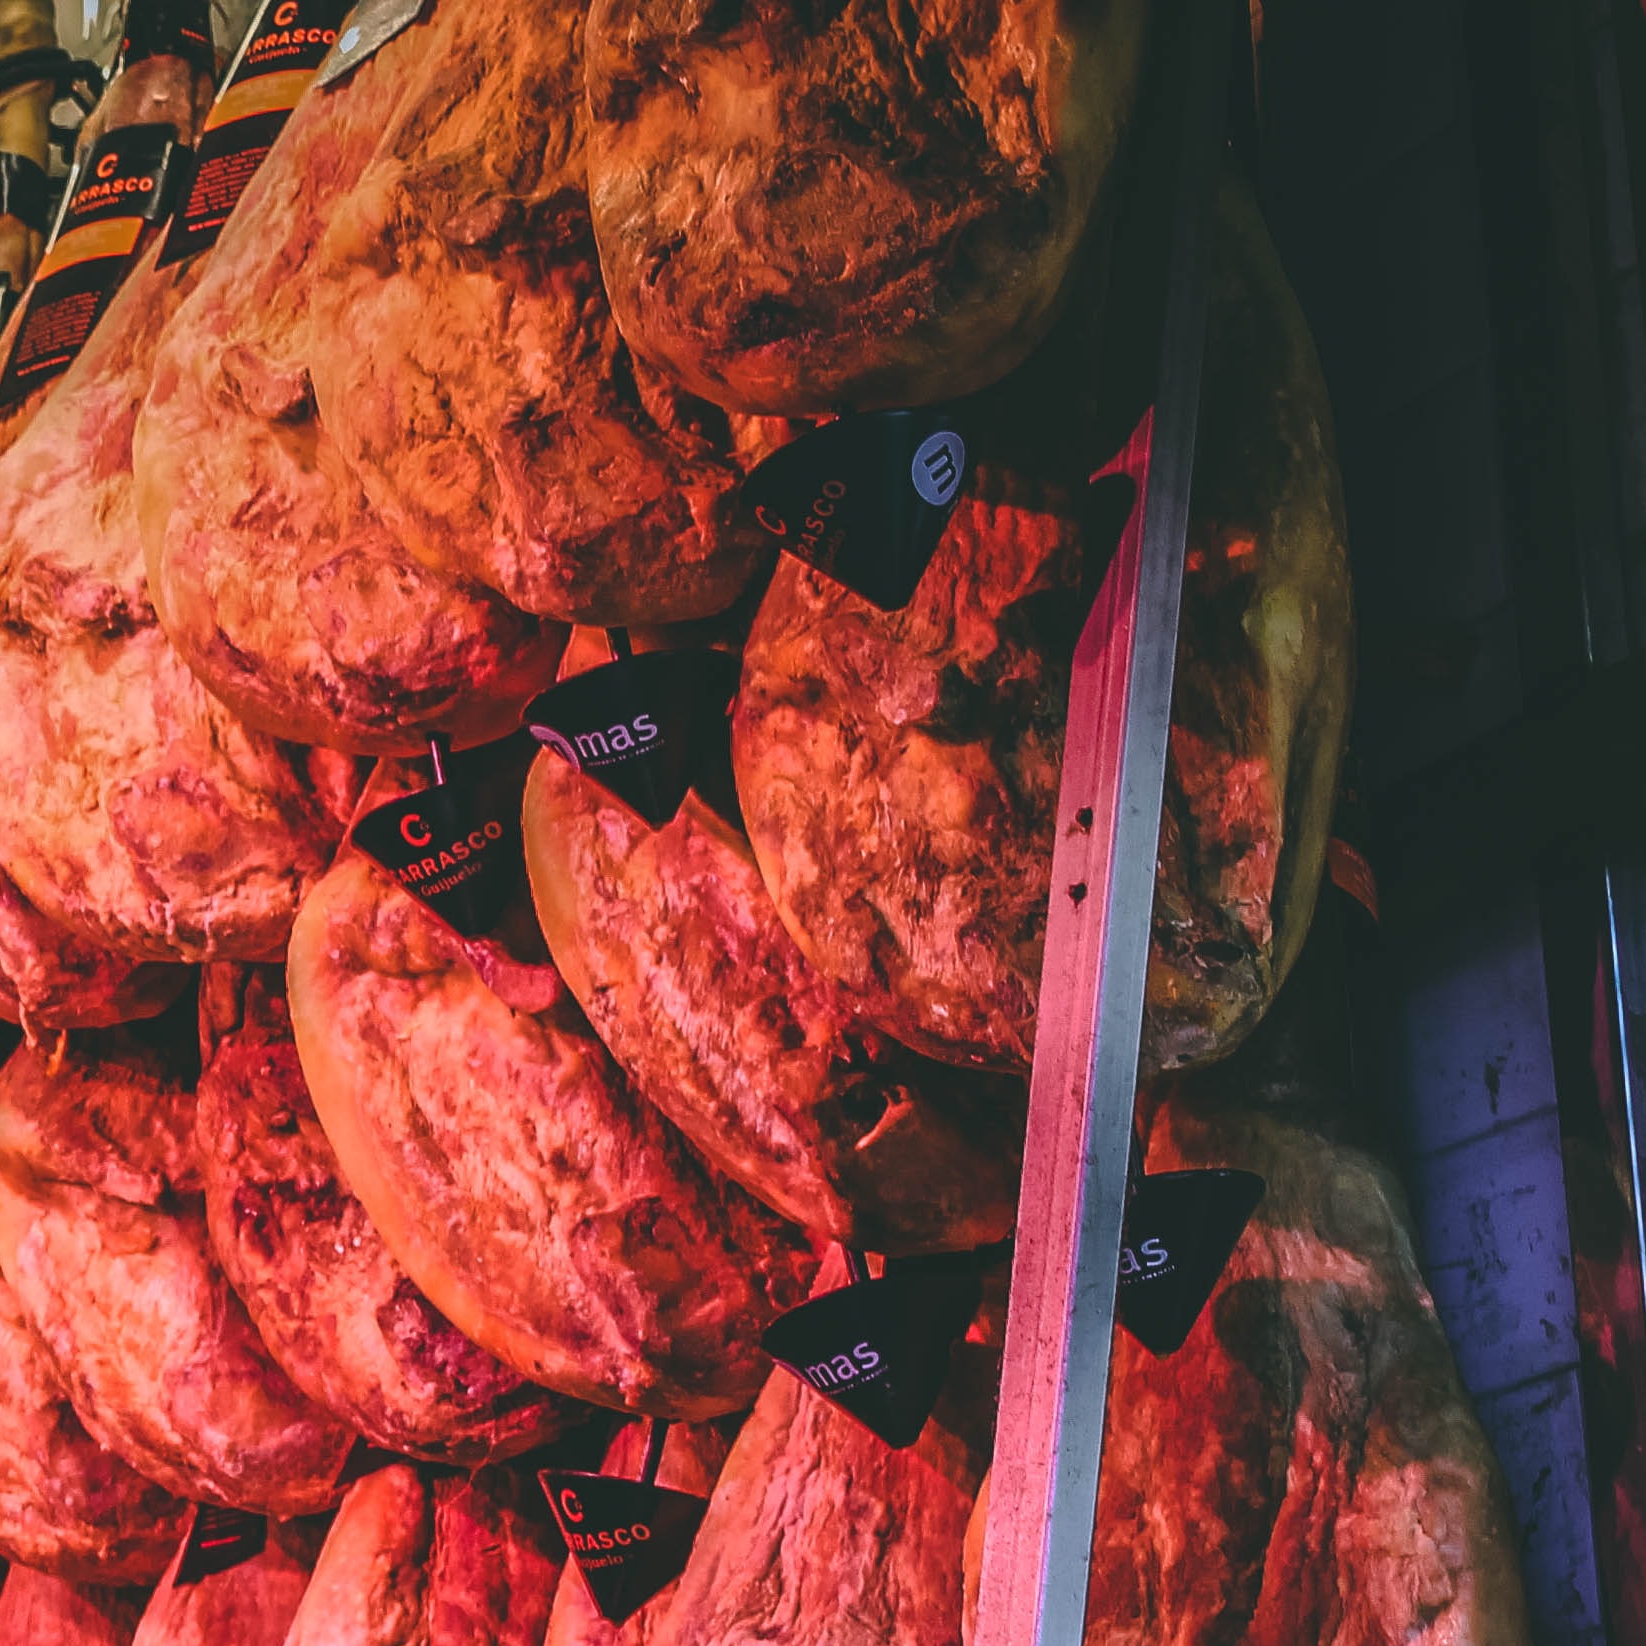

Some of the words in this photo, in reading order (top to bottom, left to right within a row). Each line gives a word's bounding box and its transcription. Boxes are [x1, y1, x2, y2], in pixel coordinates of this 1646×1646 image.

[247, 27, 338, 56] RRASCO
[70, 176, 153, 209] RRASCO
[574, 713, 658, 759] mas
[398, 820, 503, 884] ARRASCO
[1120, 1238, 1168, 1274] as
[805, 1342, 879, 1388] mas
[571, 1523, 651, 1552] RASCO
